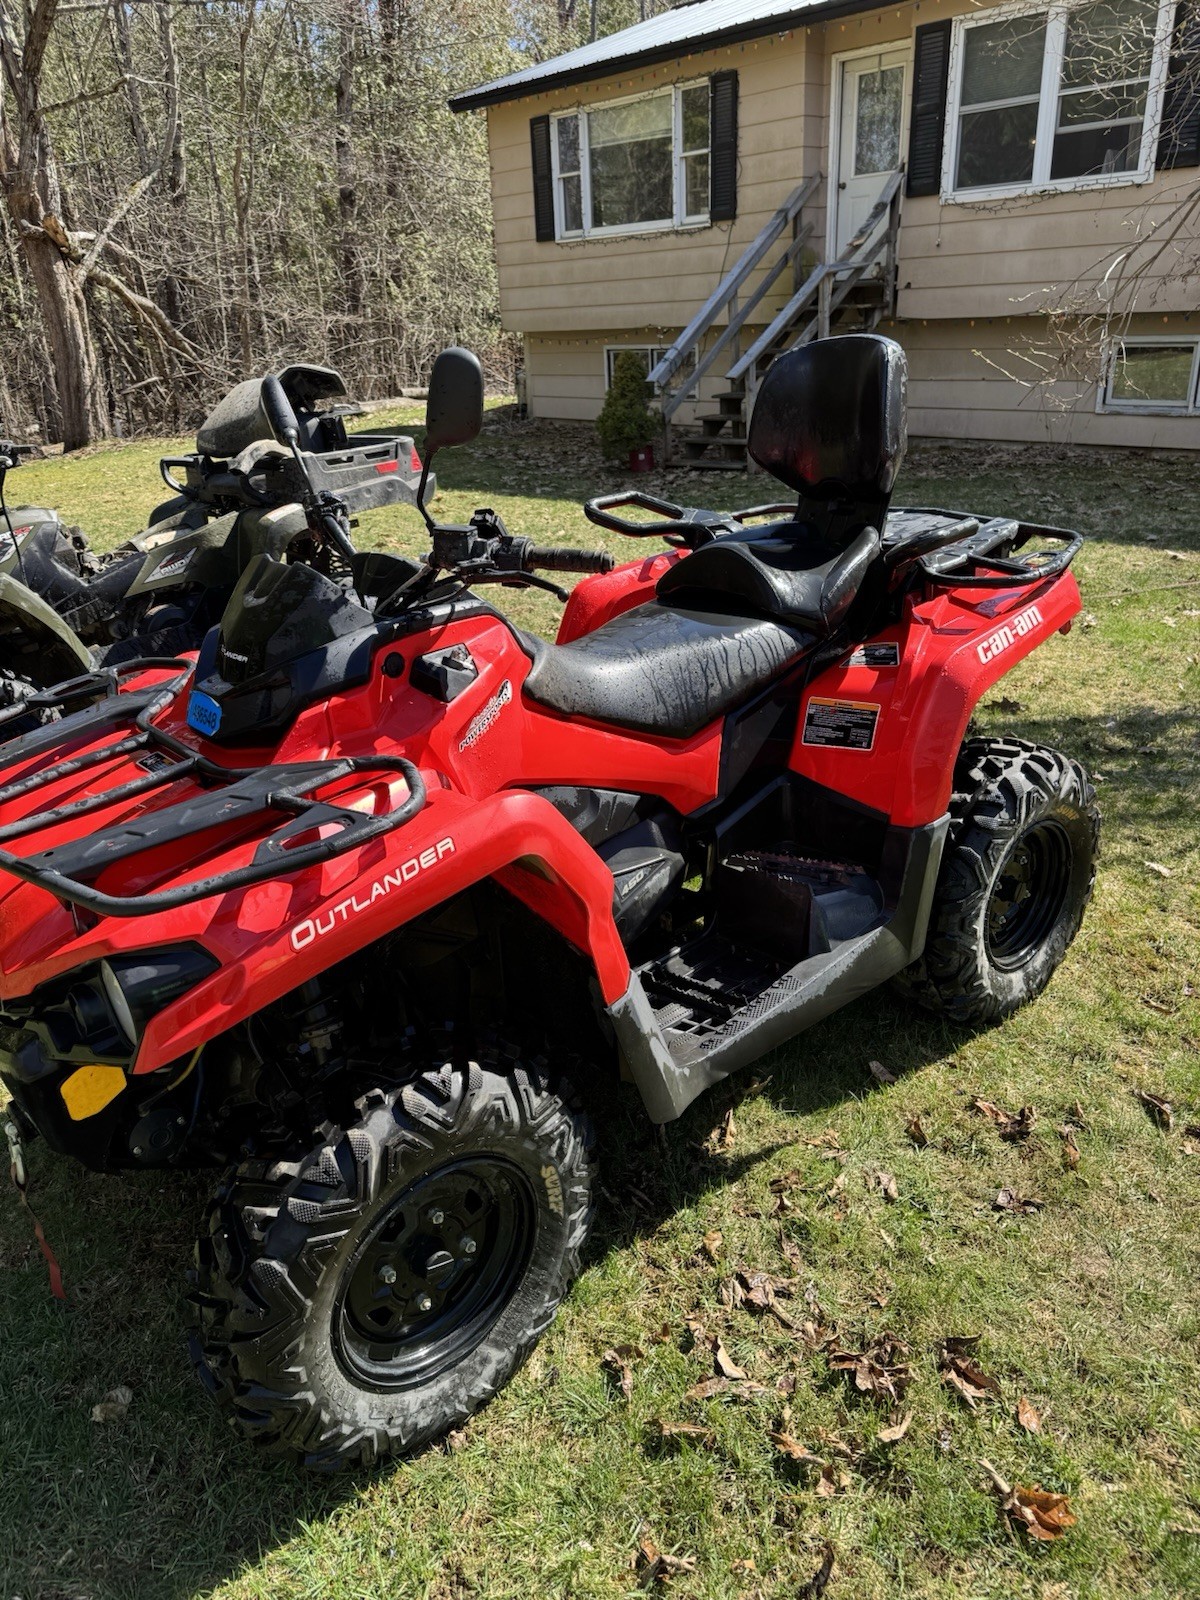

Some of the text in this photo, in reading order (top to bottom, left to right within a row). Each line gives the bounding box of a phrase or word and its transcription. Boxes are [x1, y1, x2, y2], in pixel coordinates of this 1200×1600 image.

[976, 605, 1043, 665] can-am
[290, 836, 455, 951] OUTLANDER
[621, 869, 644, 896] 450
